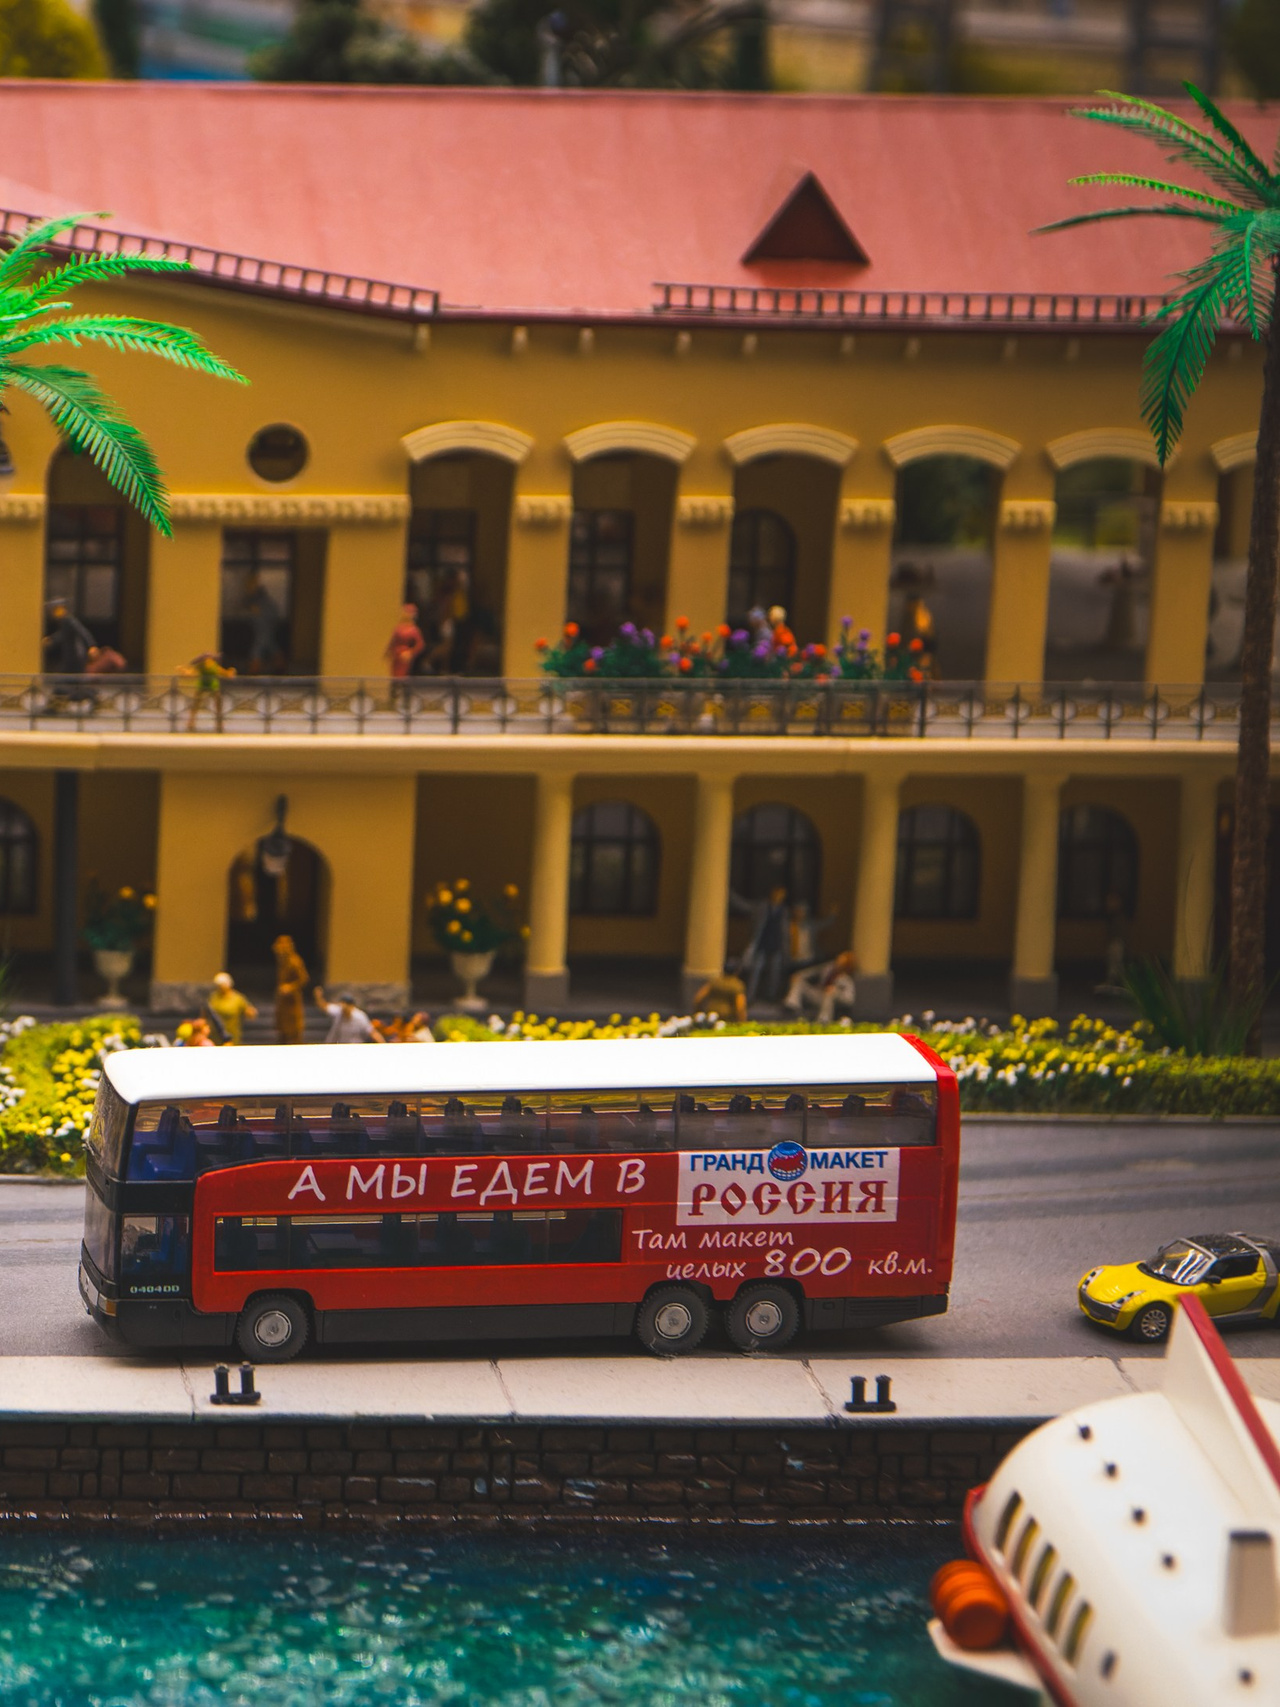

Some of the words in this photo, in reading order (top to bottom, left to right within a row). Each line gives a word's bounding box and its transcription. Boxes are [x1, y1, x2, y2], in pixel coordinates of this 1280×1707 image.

[690, 1153, 764, 1174] ГРАНД
[810, 1151, 888, 1169] МАКЕТ
[287, 1165, 326, 1201] А
[345, 1163, 427, 1200] МЫ
[451, 1159, 594, 1206] ЕДЕМ
[616, 1158, 646, 1194] В
[688, 1180, 888, 1216] РОССИЯ
[632, 1229, 687, 1249] Там
[699, 1230, 794, 1249] макет
[666, 1262, 747, 1280] целых
[764, 1247, 852, 1276] 800
[868, 1251, 933, 1275] кв.м.
